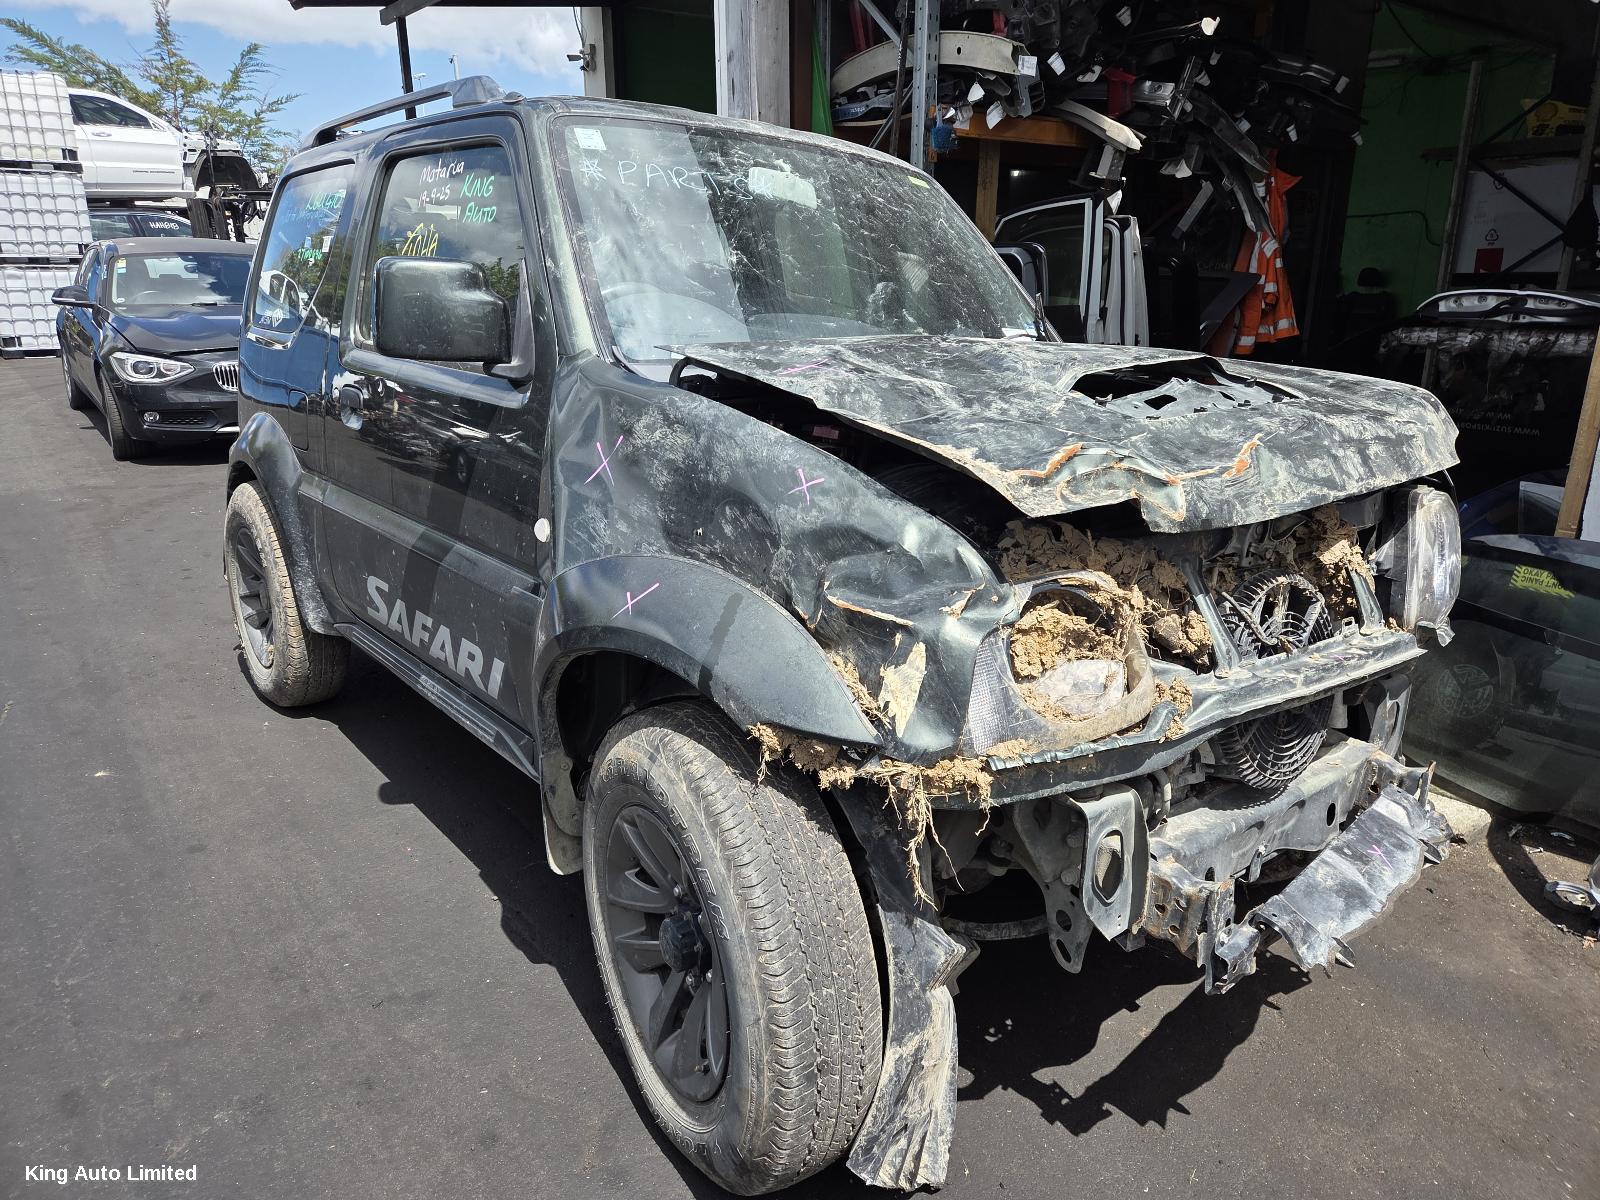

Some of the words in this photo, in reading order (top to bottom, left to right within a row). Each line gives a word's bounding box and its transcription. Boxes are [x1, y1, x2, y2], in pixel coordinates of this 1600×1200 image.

[460, 172, 495, 199] KING
[617, 160, 754, 200] PARTS
[1523, 567, 1545, 578] OKAY
[366, 575, 505, 700] SAFARI
